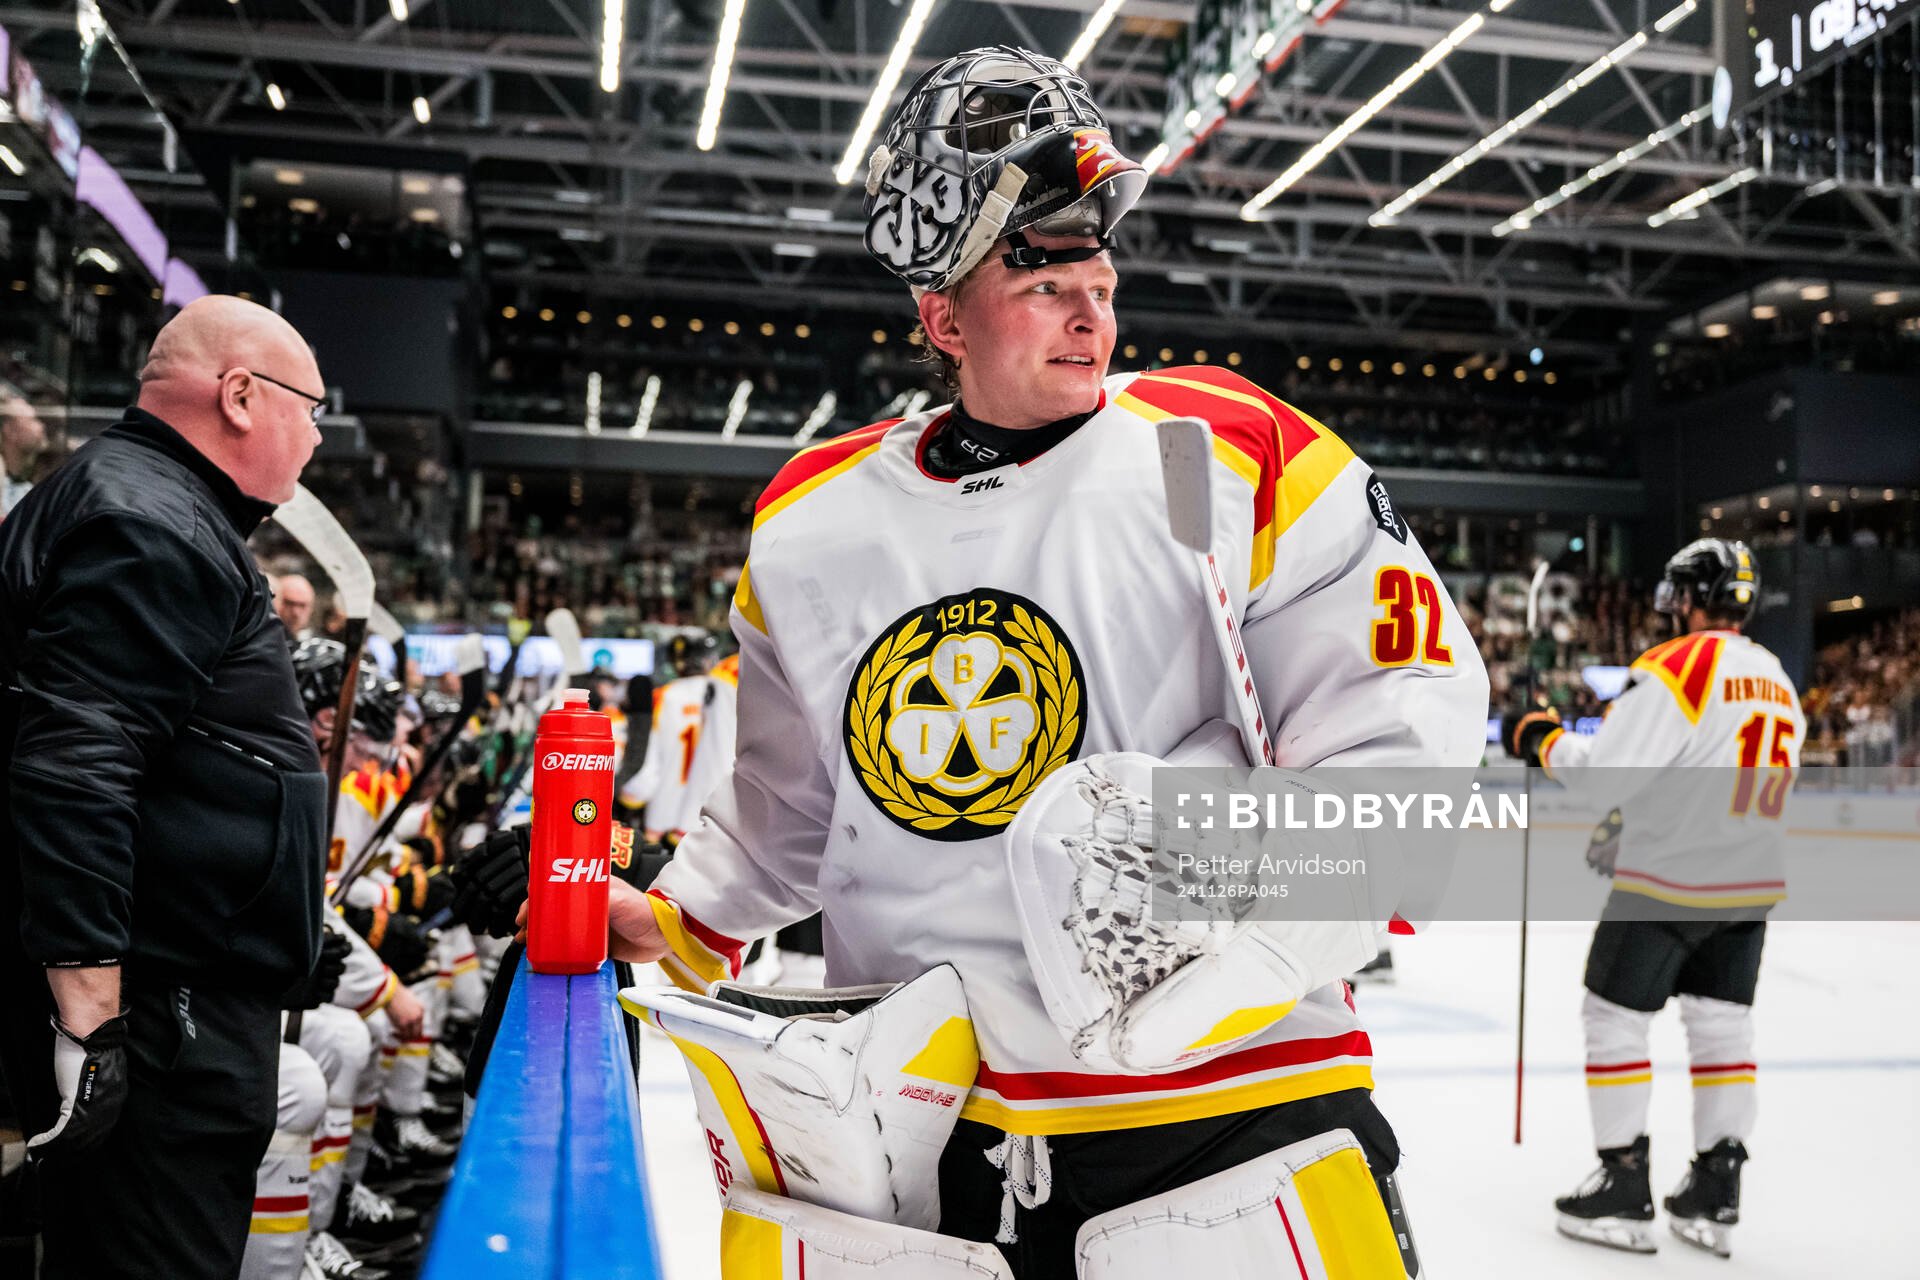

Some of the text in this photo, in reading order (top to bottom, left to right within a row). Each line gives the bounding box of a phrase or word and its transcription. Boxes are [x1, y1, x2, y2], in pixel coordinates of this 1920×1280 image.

[961, 475, 1004, 494] SHL
[936, 599, 998, 632] 1912
[1370, 565, 1454, 668] 32
[953, 653, 976, 685] B
[990, 716, 1012, 750] F
[1729, 711, 1795, 820] 15
[548, 858, 609, 883] SHL
[899, 1084, 957, 1107] SHADOW
